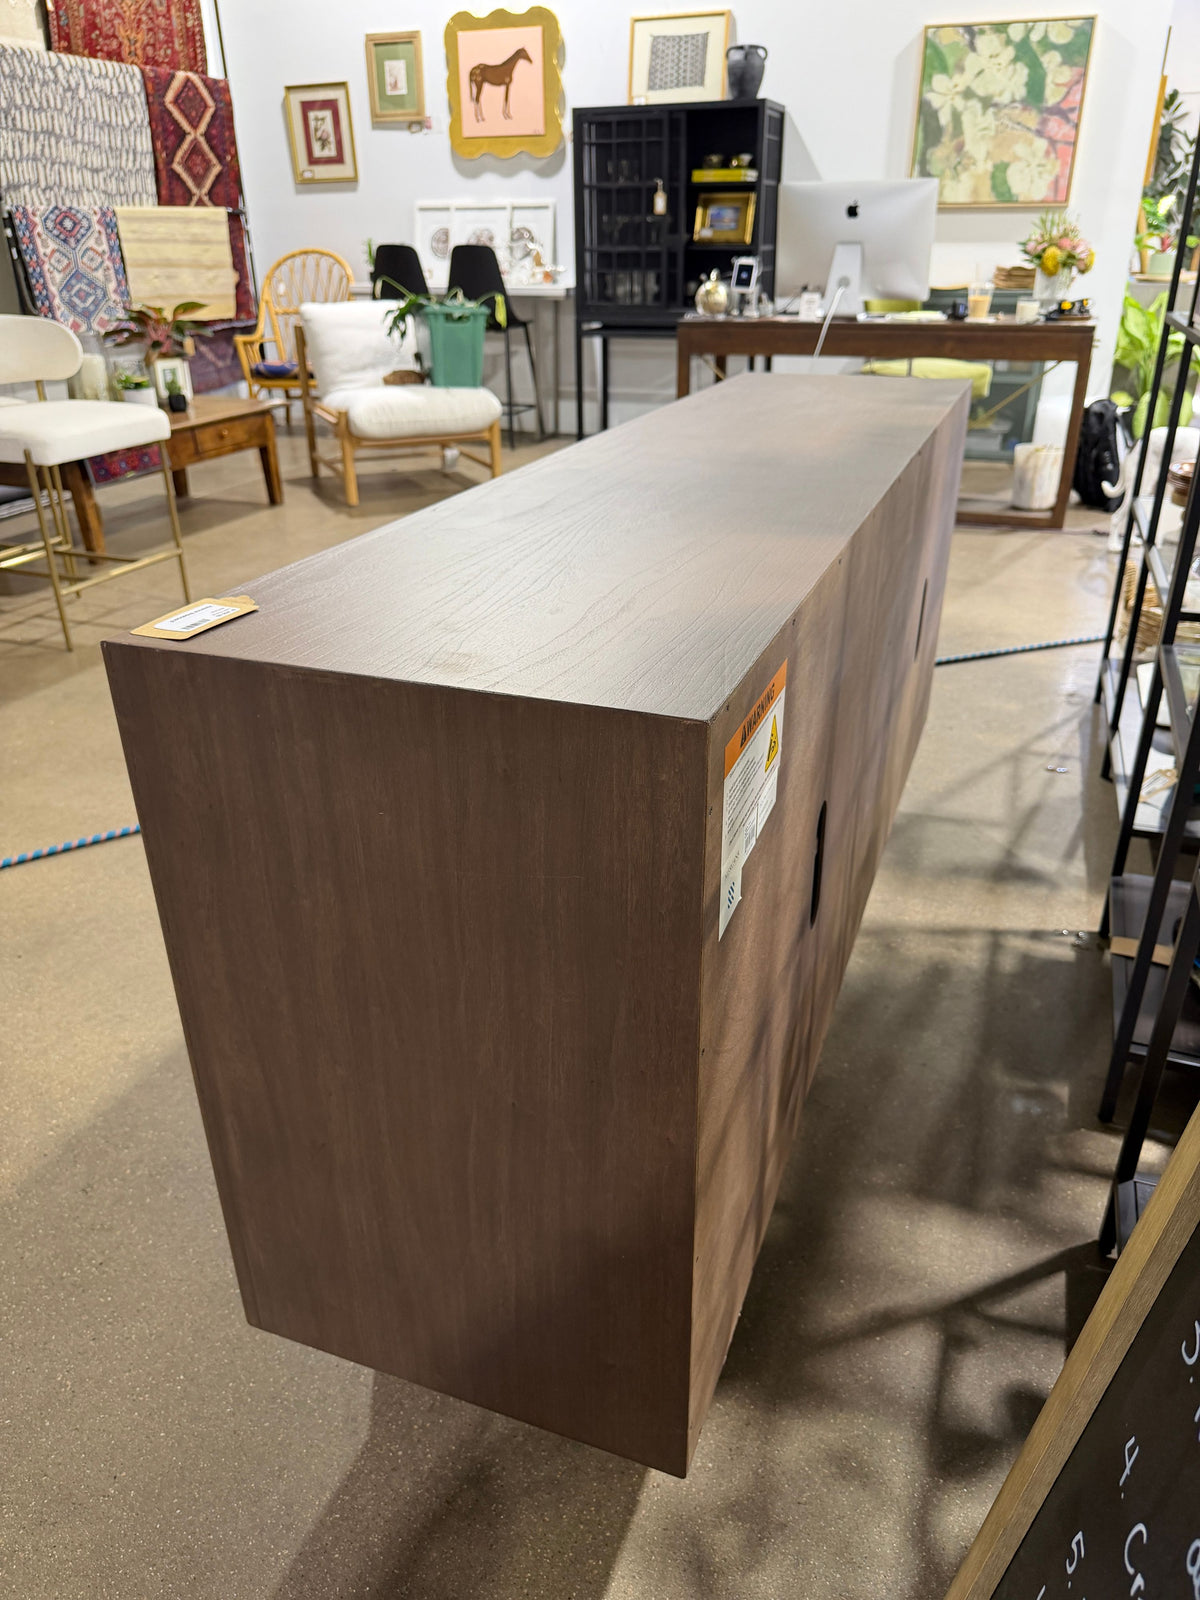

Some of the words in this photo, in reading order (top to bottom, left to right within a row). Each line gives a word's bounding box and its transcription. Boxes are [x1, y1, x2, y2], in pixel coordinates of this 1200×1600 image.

[746, 683, 775, 737] WARNING
[1119, 1435, 1139, 1500] 4.
[1066, 1530, 1085, 1589] 5.
